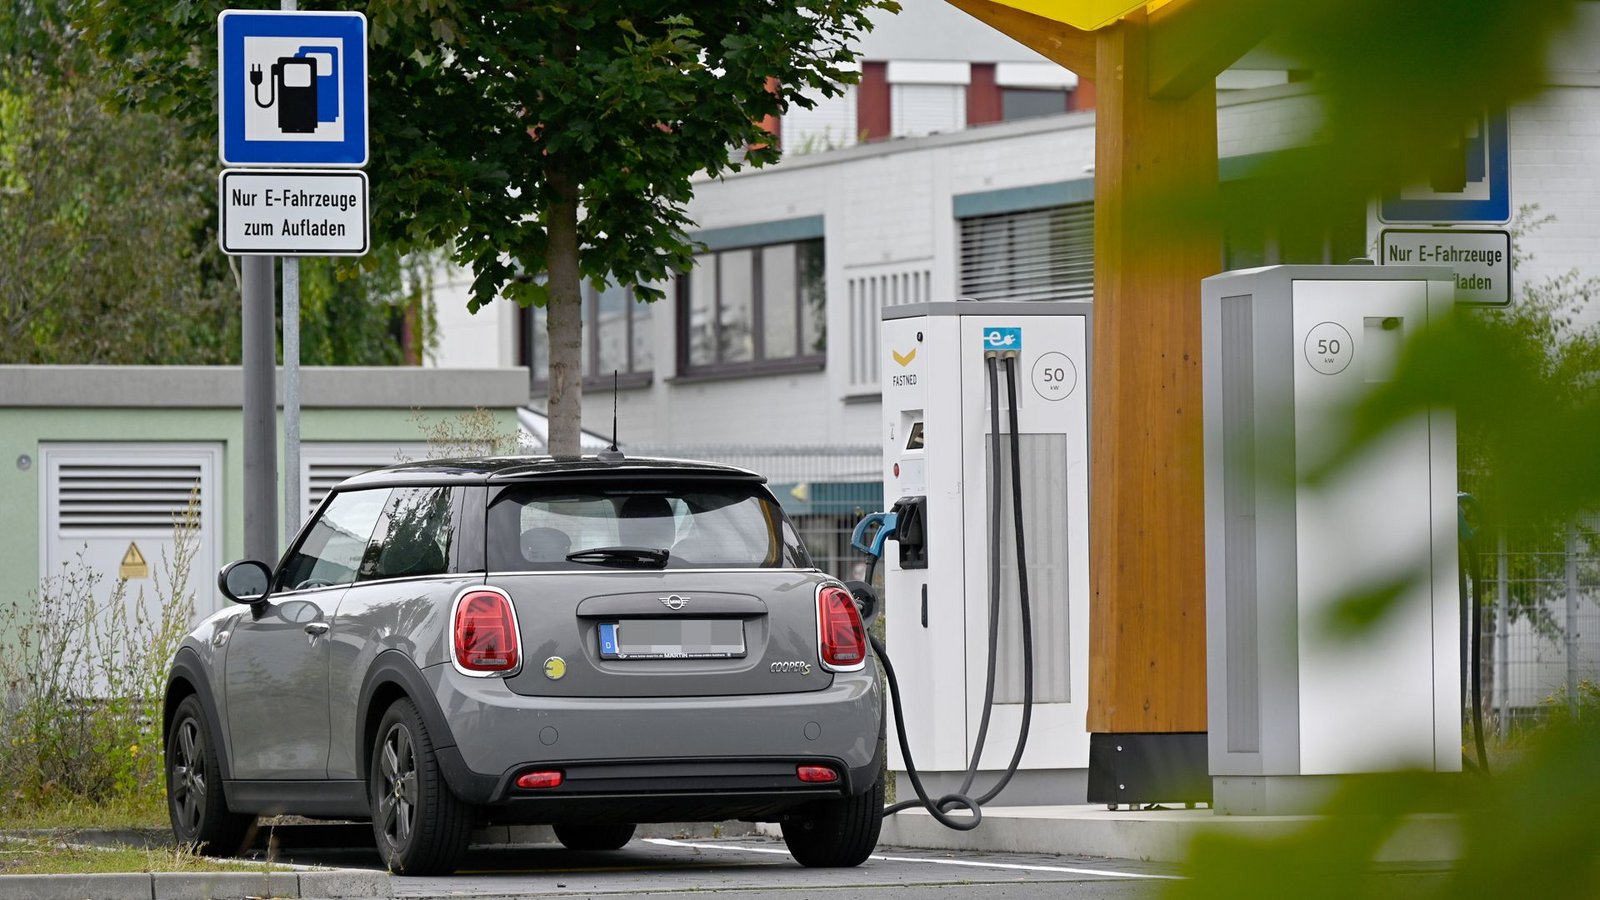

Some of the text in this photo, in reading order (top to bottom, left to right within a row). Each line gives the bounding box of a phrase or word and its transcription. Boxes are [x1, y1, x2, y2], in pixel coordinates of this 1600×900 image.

[232, 189, 357, 212] Nur E-Fahrzeuge
[244, 219, 346, 236] zum Aufladen
[1389, 245, 1502, 267] Nur E-Fahrzeuge
[1453, 273, 1492, 290] laden
[1318, 339, 1340, 355] 50
[892, 374, 918, 387] FASTNED
[1044, 368, 1065, 382] 50
[605, 641, 612, 649] D
[770, 661, 806, 673] COOPER
